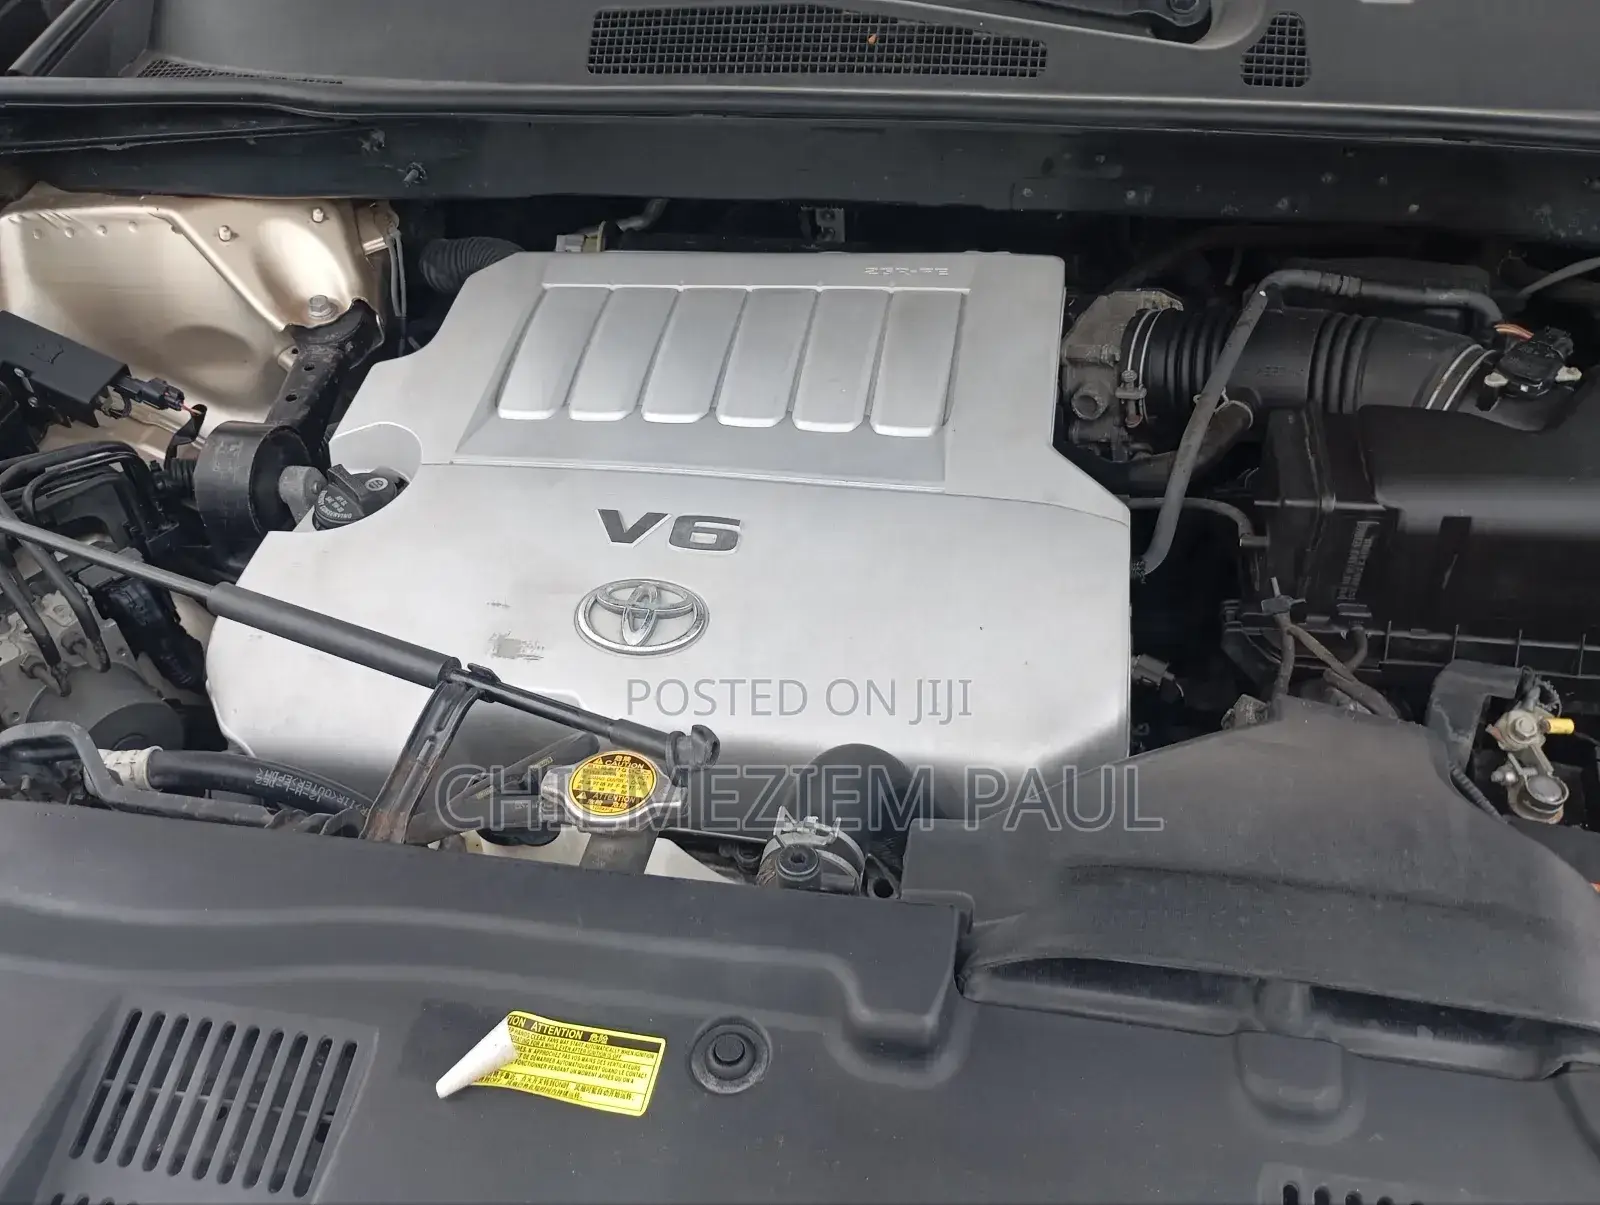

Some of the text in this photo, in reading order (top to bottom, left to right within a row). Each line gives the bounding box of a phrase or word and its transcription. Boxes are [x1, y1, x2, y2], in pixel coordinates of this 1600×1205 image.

[596, 509, 741, 552] V6
[604, 760, 645, 769] CAUTION
[530, 1021, 584, 1040] ATTENTION
